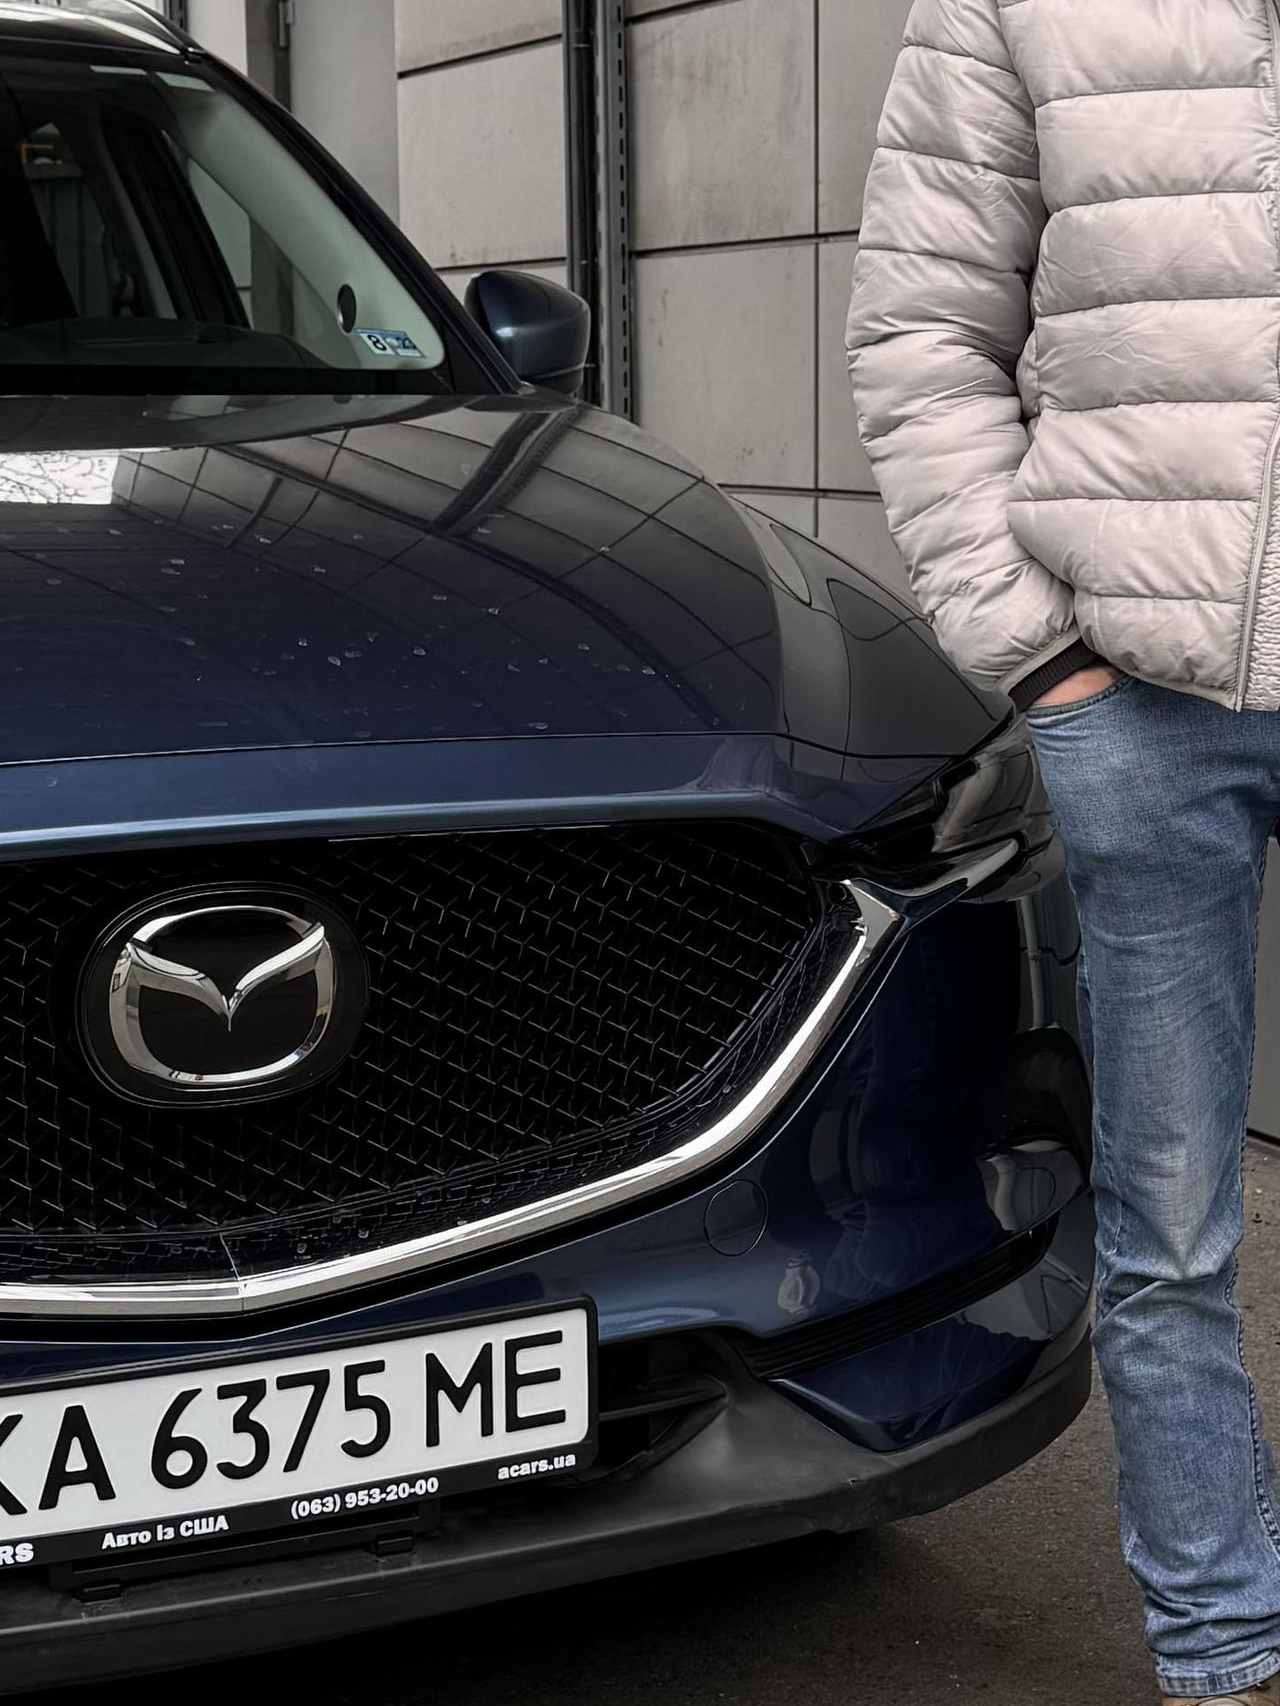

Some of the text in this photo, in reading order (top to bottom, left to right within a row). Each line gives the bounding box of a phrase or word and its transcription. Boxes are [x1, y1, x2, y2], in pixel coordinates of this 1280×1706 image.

[366, 334, 387, 351] 8
[150, 1359, 392, 1491] 6375
[424, 1330, 568, 1448] ME
[496, 1452, 577, 1480] acars.ua
[290, 1477, 440, 1520] (063) 953-20-00
[101, 1531, 152, 1550] Авто
[180, 1515, 230, 1537] США
